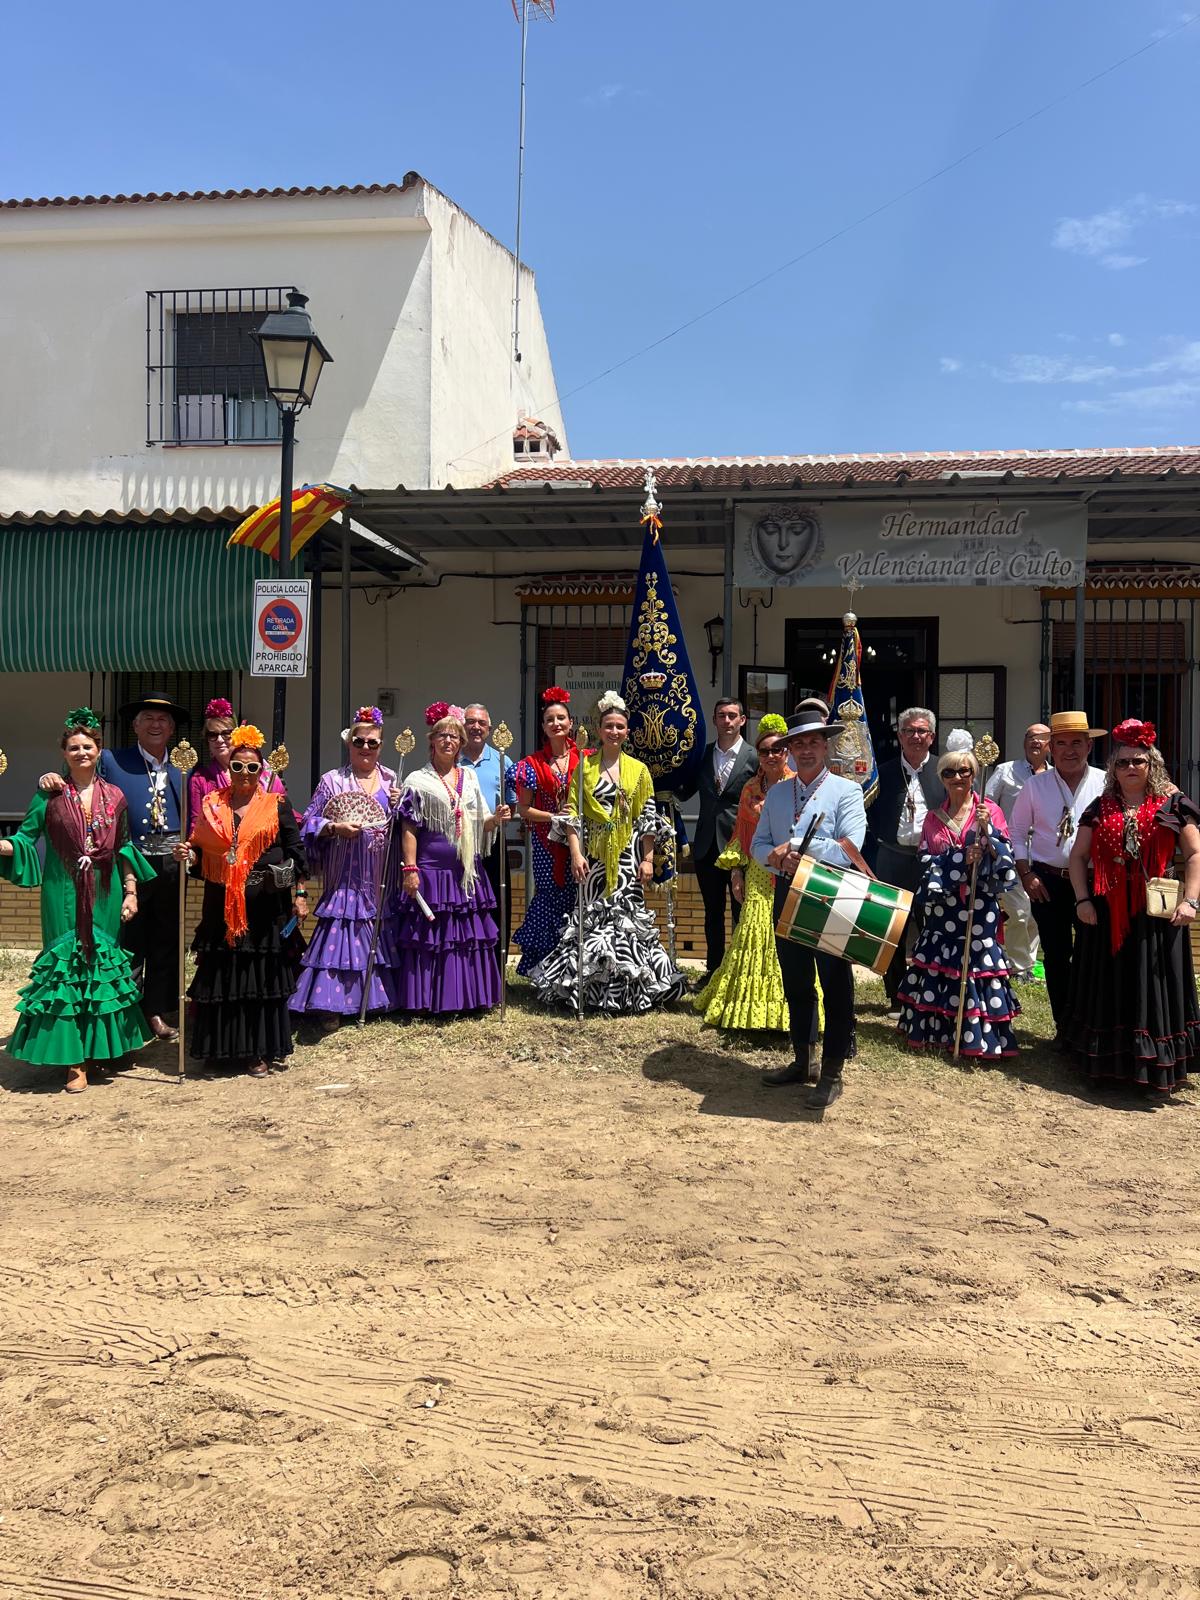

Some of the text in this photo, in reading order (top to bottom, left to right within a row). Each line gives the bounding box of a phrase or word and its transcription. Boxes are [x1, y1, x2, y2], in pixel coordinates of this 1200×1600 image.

[881, 510, 1027, 538] Hermandad
[838, 551, 1073, 578] Valenciana de Culto
[257, 584, 307, 593] POLICÍA LOCAL
[255, 652, 303, 661] PROHIBIDO
[258, 663, 299, 673] APARCAR
[631, 692, 680, 713] VALENCIANA
[648, 749, 673, 762] CULTO
